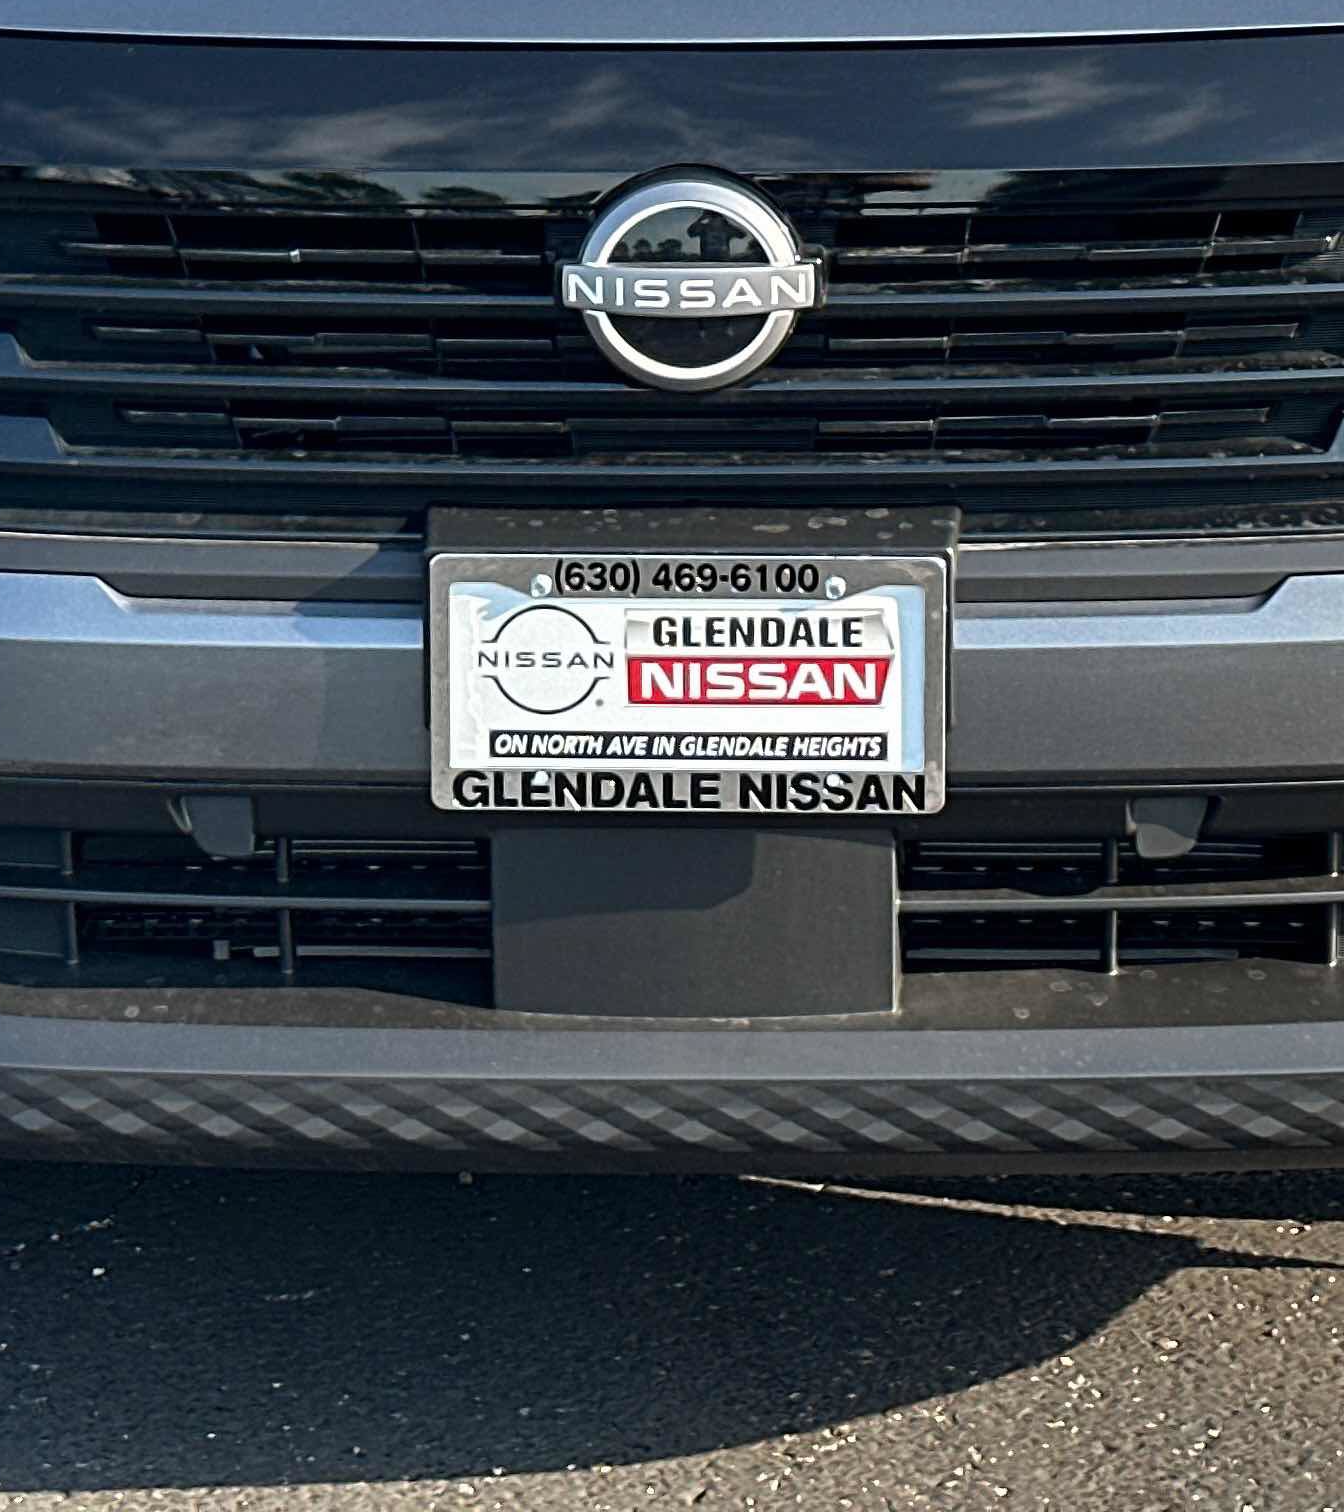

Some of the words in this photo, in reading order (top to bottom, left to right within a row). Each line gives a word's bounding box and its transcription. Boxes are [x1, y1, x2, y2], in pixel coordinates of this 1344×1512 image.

[567, 273, 806, 309] NISSAN
[554, 557, 640, 596] (630)
[652, 562, 819, 593] 469-6100
[652, 615, 864, 649] GLENDALE
[477, 649, 615, 670] NISSAN
[639, 661, 878, 701] NISSAN
[494, 733, 528, 755] ON
[530, 734, 604, 756] NORTH
[606, 735, 649, 756] AVE
[652, 735, 676, 756] IN
[679, 735, 788, 757] GLENDALE
[792, 736, 882, 758] HEIGHTS
[452, 769, 721, 810] GLENDALE
[738, 772, 926, 812] NISSAN
